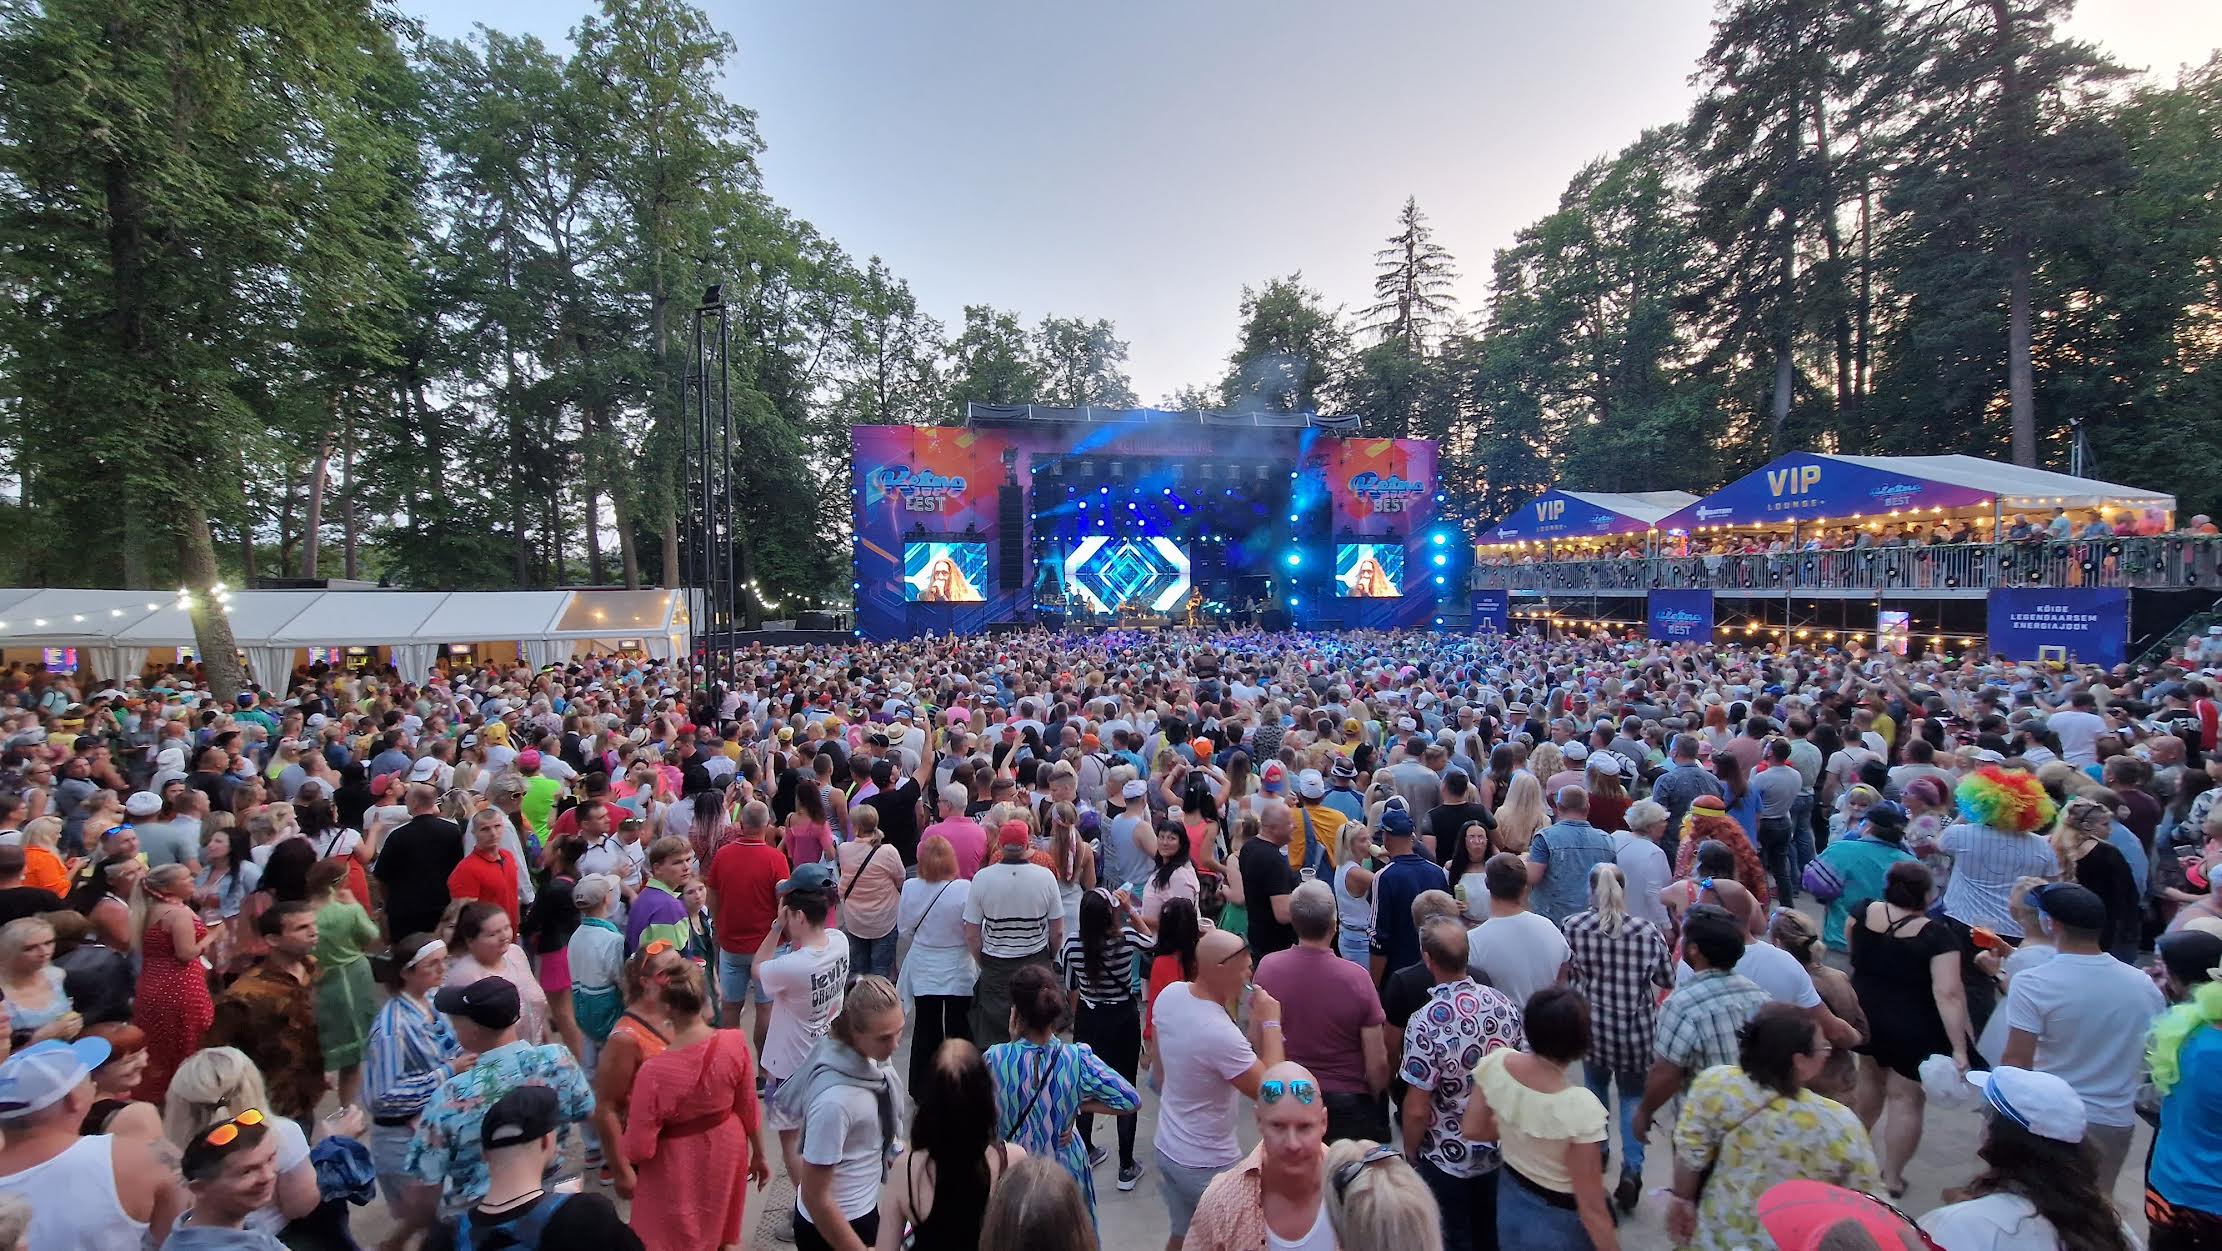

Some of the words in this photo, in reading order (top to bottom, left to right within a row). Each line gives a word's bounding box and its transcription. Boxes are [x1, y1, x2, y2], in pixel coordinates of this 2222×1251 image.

[1767, 465, 1821, 497] VIP
[1373, 499, 1409, 513] BEST
[1536, 500, 1565, 522] VIP
[1767, 499, 1818, 512] LOUNGE
[2010, 613, 2097, 622] LEGENDAARSEM
[1668, 625, 1691, 635] BEST
[2013, 622, 2089, 631] ENERGIAJOOK
